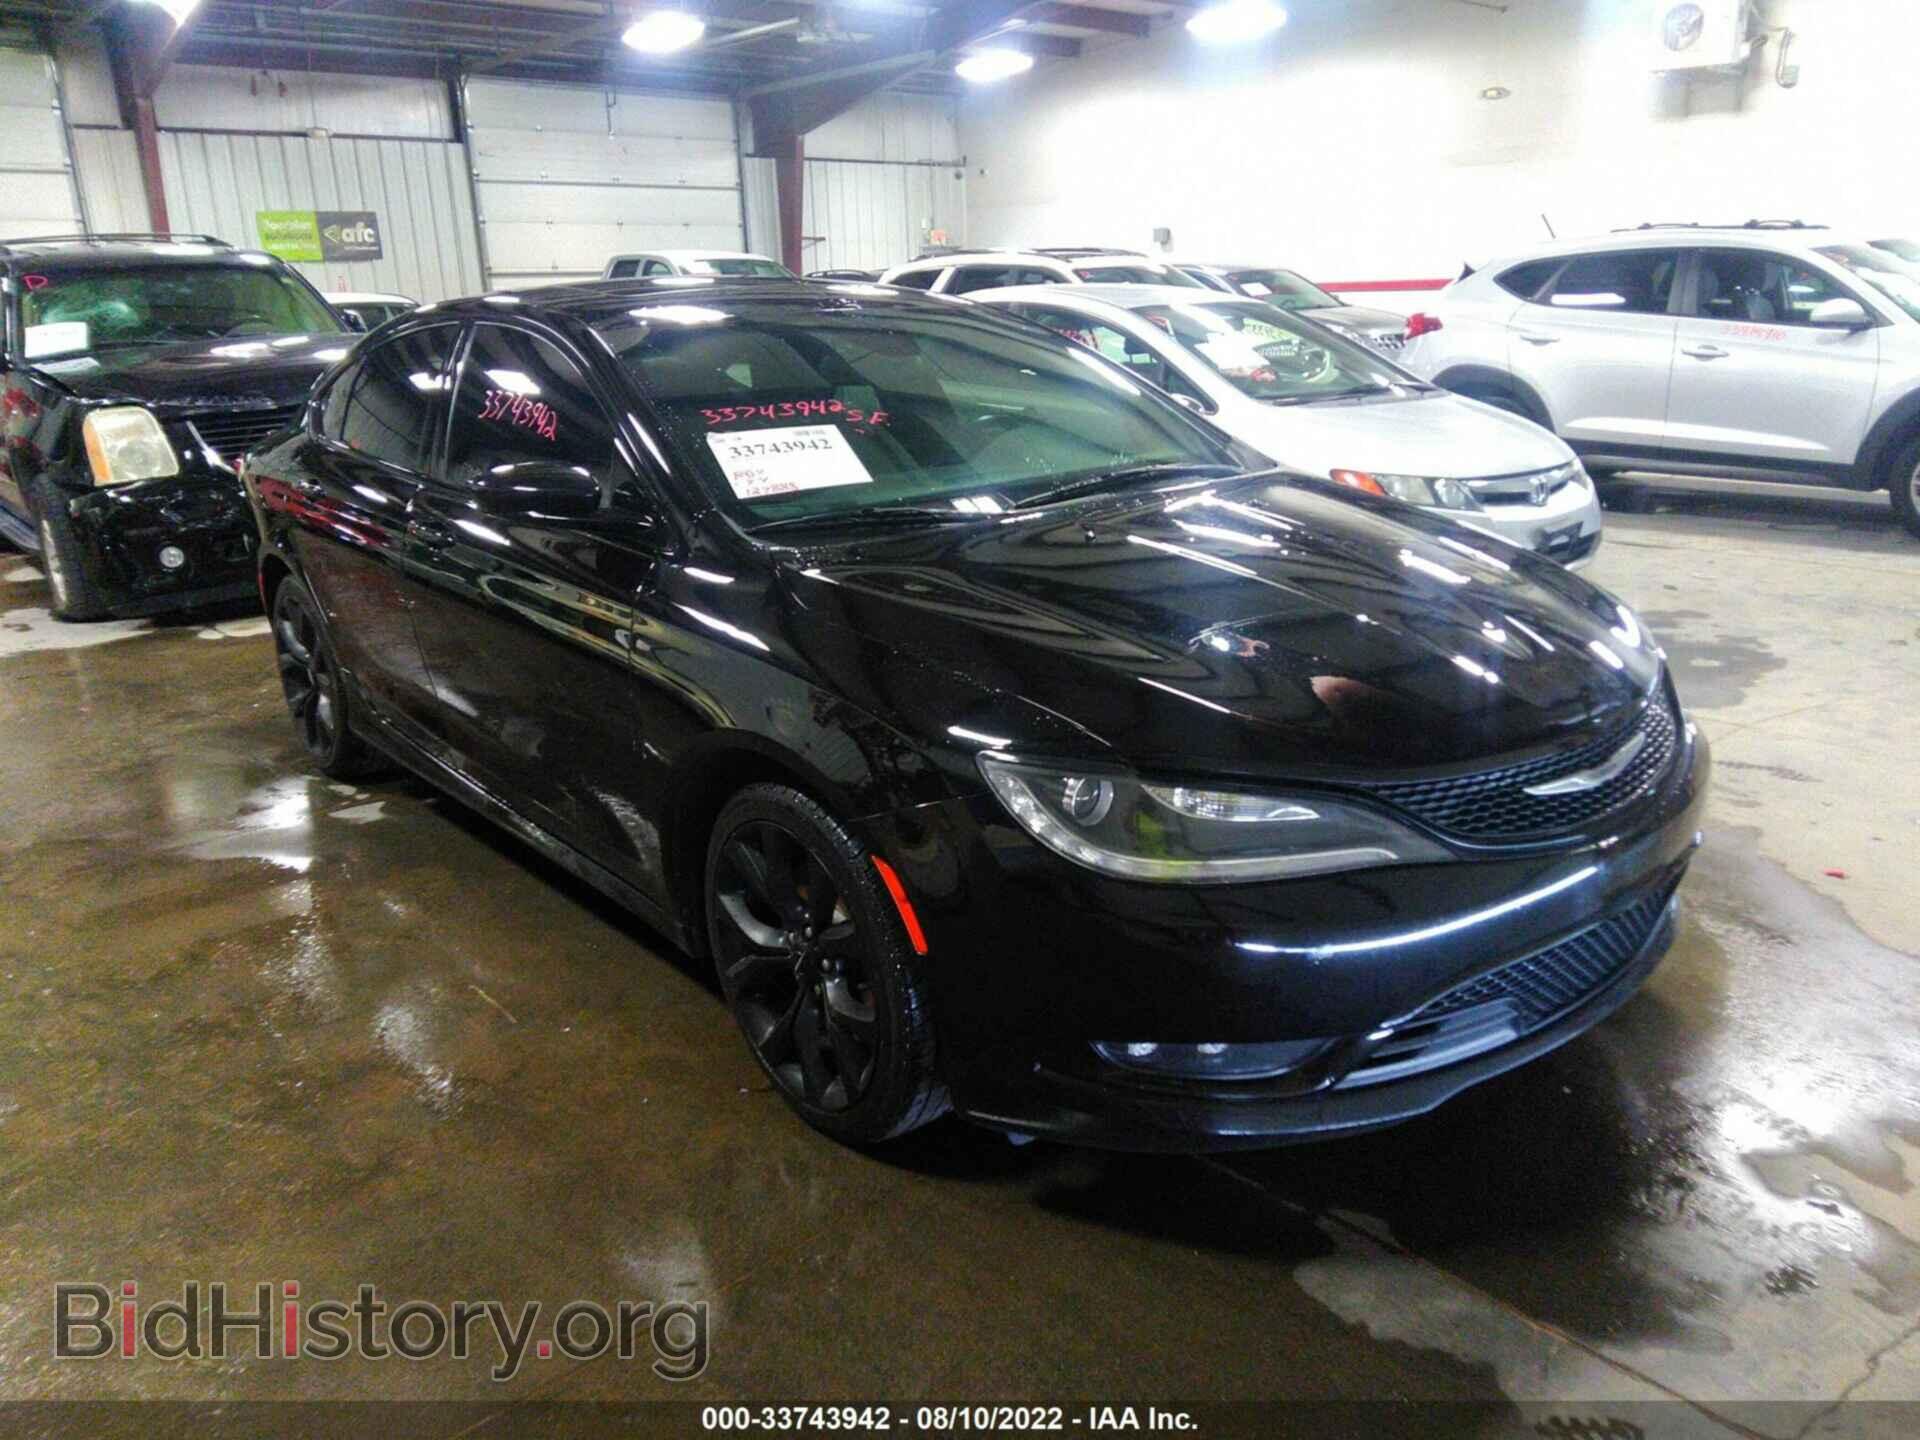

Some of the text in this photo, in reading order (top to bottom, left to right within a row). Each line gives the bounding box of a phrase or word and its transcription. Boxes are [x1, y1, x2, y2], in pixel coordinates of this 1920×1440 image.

[341, 220, 376, 243] afc
[478, 389, 557, 441] 33743942
[700, 399, 846, 425] 33743942
[728, 438, 833, 459] 33743942
